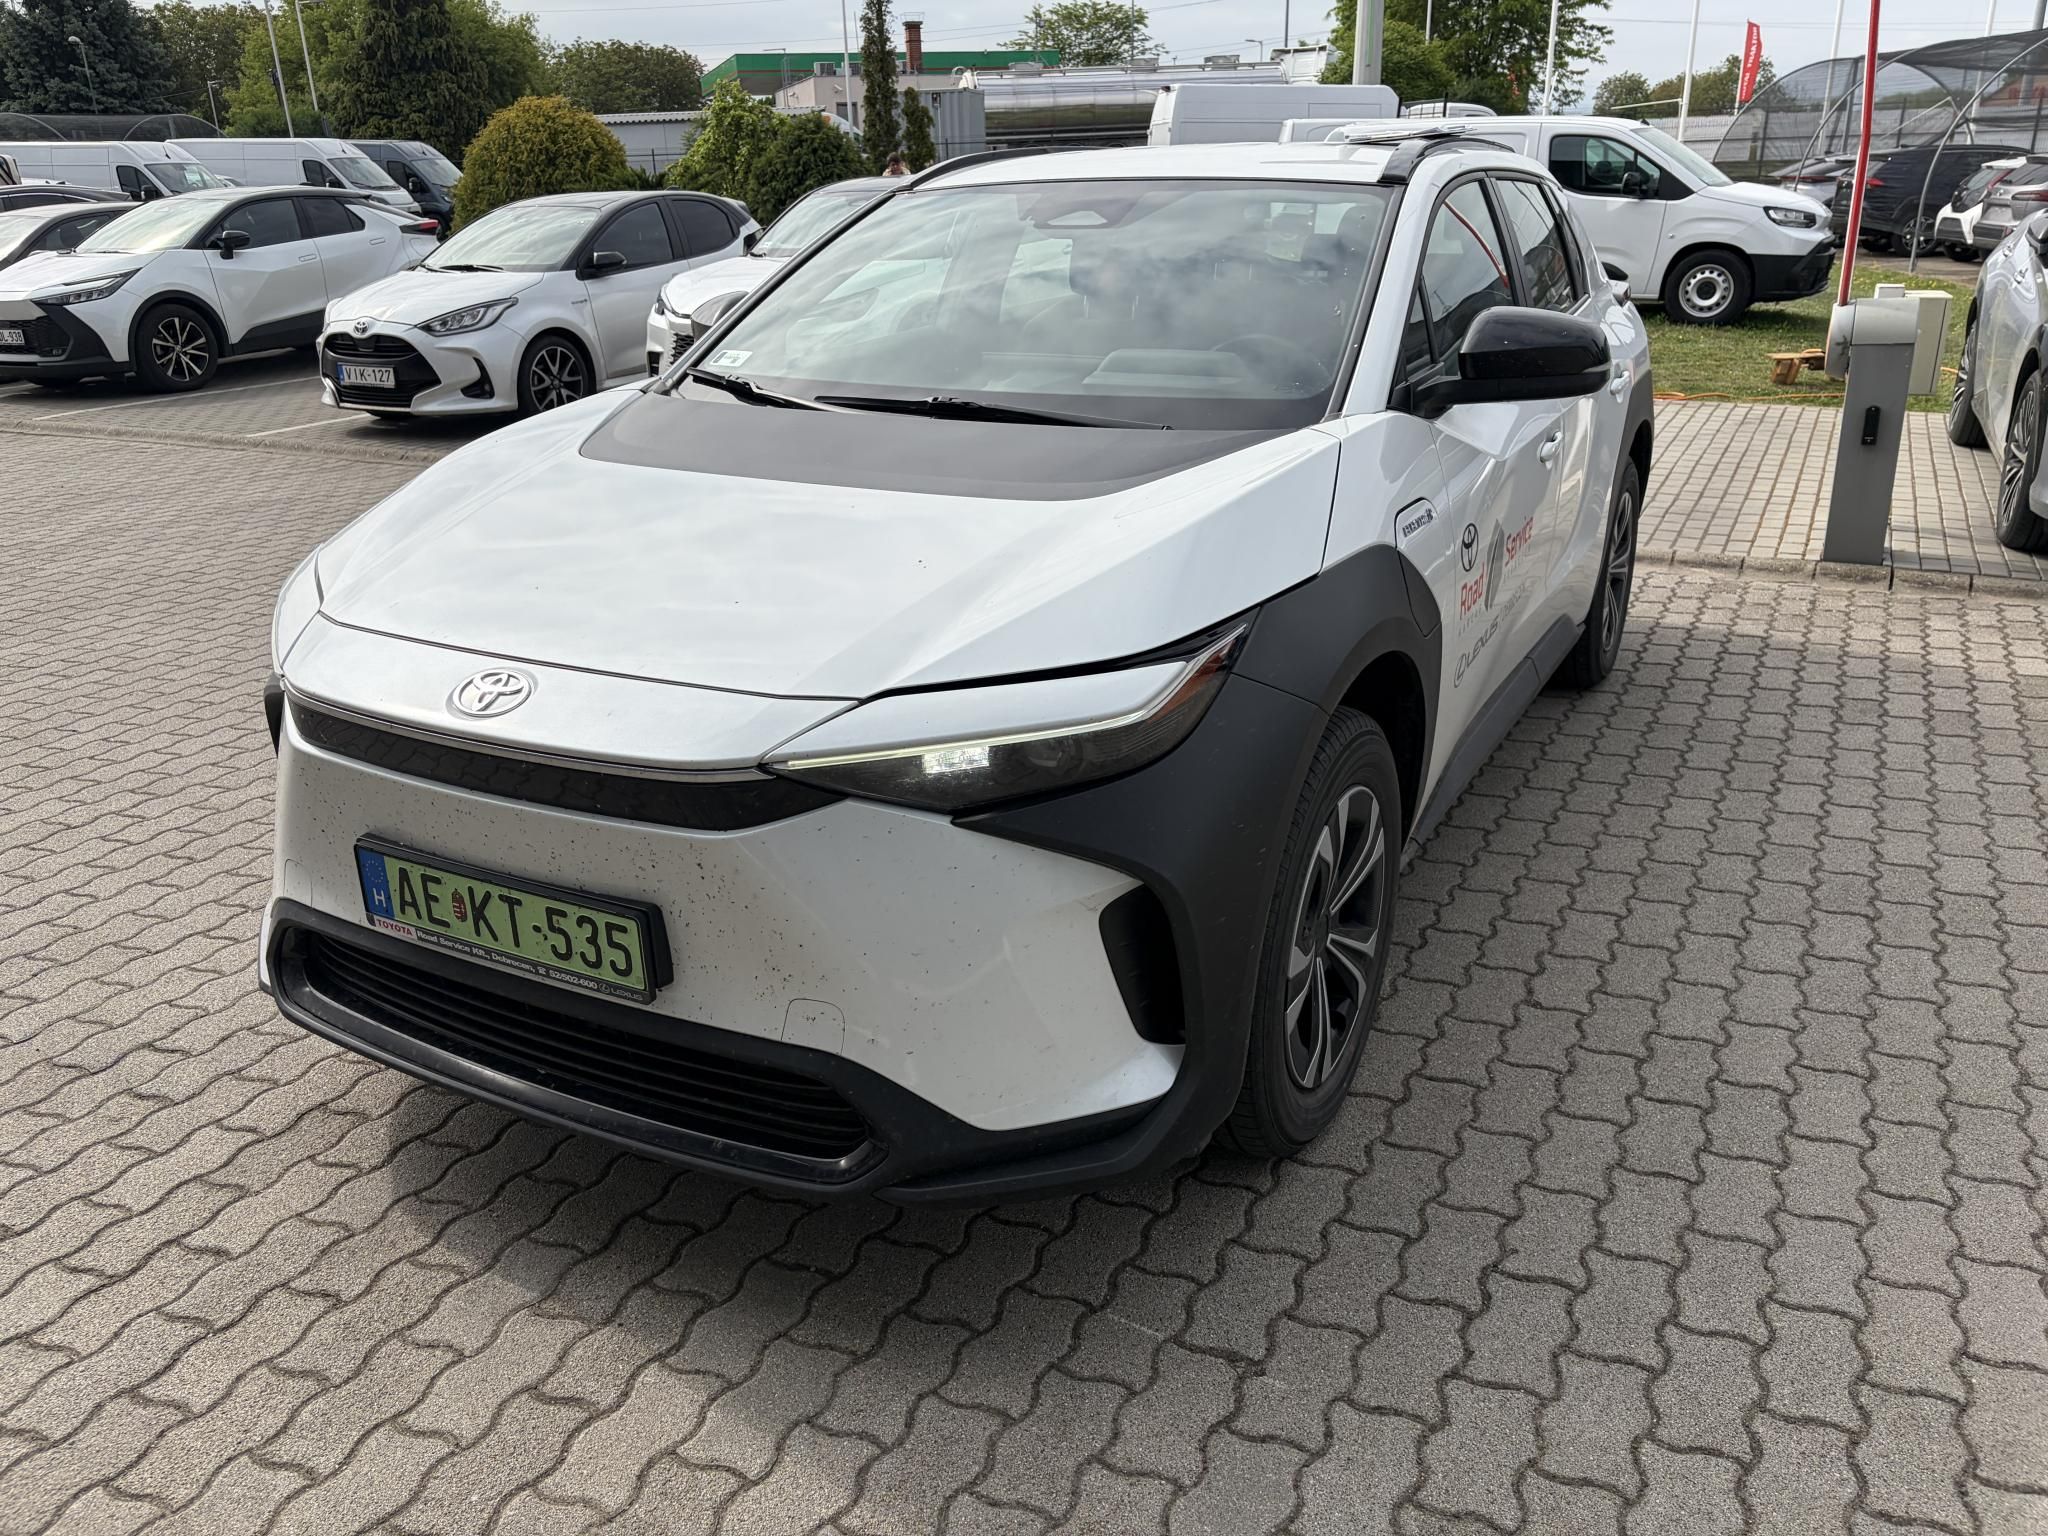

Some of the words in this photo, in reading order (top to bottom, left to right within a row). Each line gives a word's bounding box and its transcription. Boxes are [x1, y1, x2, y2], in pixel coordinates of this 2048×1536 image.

[1747, 26, 1758, 68] TRAKTOR
[344, 367, 391, 383] VIK-127
[1459, 562, 1485, 620] Road
[1505, 516, 1534, 566] Service
[373, 887, 387, 908] H
[376, 918, 413, 936] TOYOTA
[416, 930, 438, 943] Road
[440, 937, 471, 953] Service
[610, 987, 643, 1001] LEXUS
